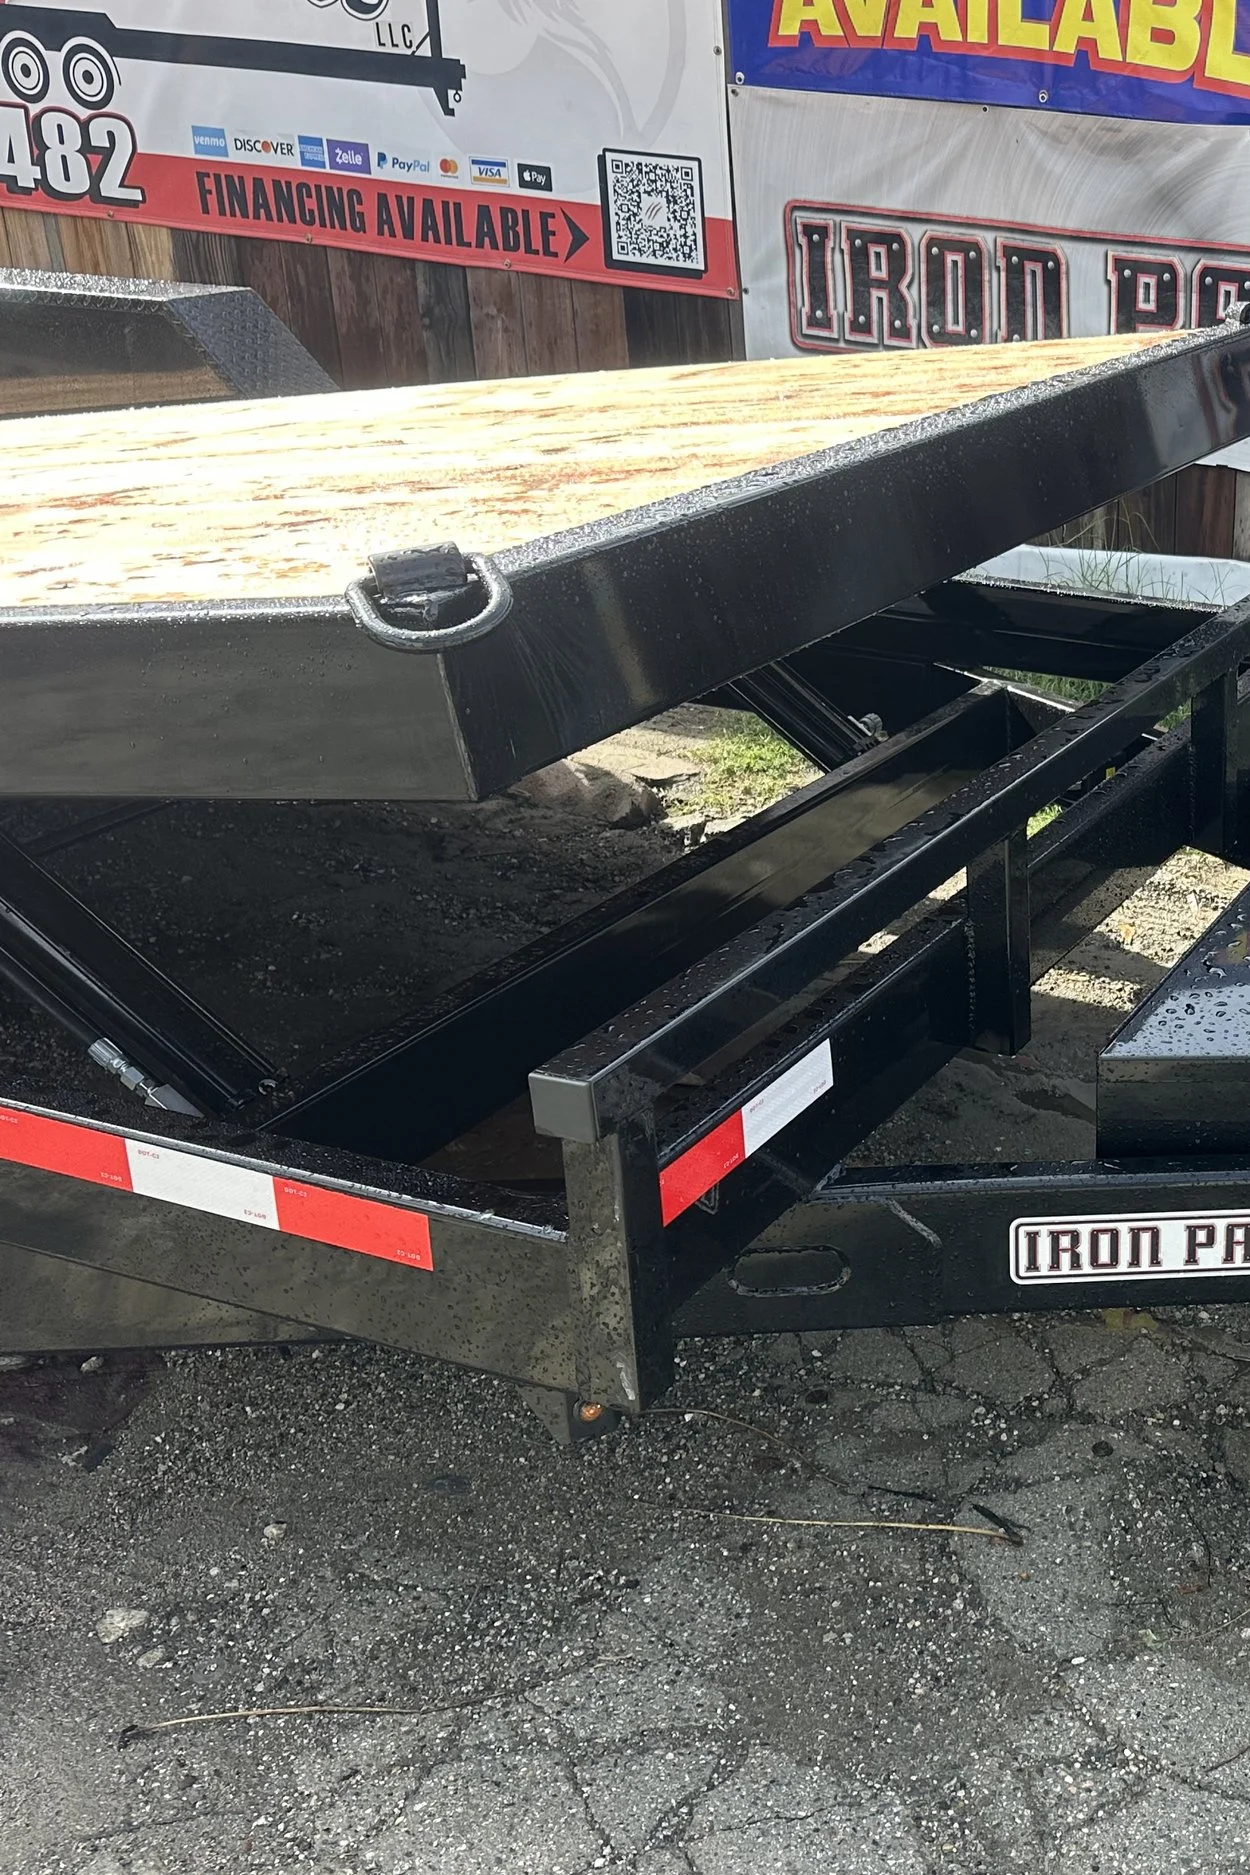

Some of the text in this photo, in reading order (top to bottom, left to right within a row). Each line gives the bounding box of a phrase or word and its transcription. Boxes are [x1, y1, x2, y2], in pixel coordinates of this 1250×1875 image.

[375, 22, 413, 49] LLC
[193, 134, 226, 148] venmo
[233, 138, 295, 157] DISCOVER
[0, 104, 145, 204] 482
[335, 147, 363, 165] Zelle
[391, 157, 430, 173] PayPal
[478, 166, 502, 178] VISA
[531, 171, 546, 185] Pay
[195, 171, 560, 258] FINANCING AVAILABLE
[796, 216, 1069, 348] IRON
[1024, 1226, 1163, 1271] IRON
